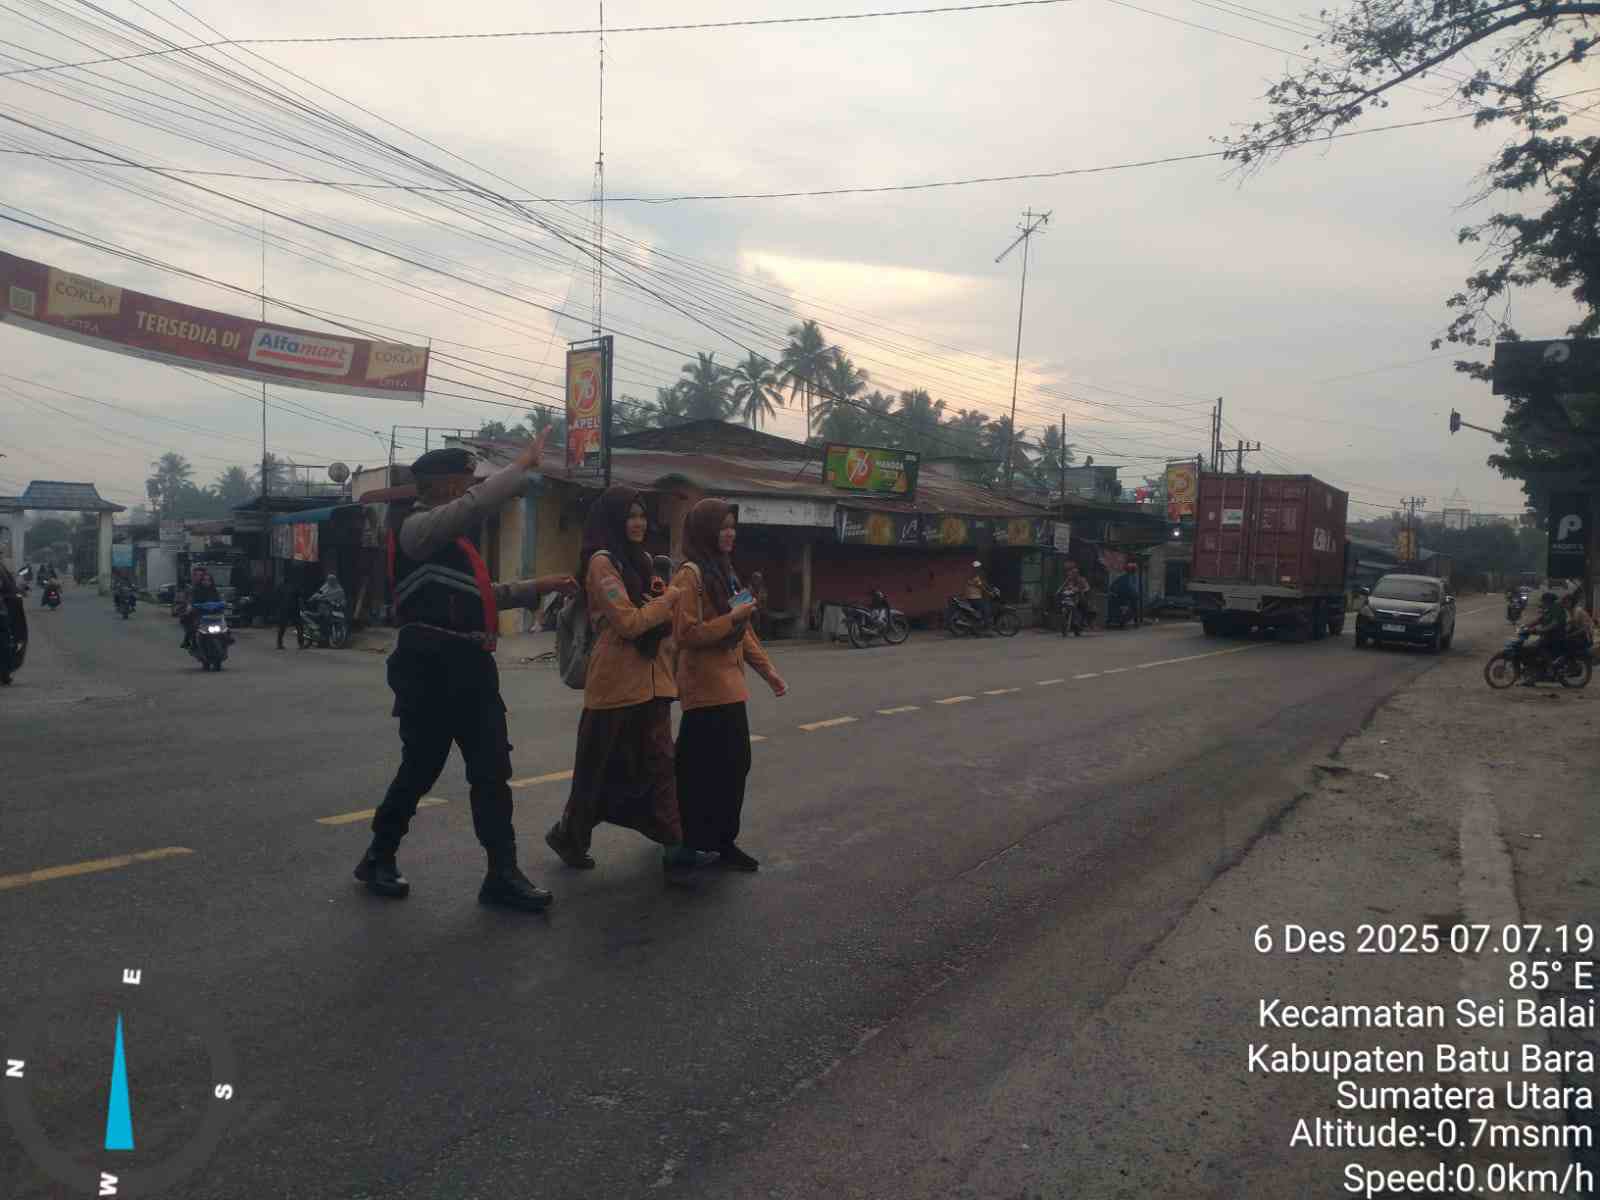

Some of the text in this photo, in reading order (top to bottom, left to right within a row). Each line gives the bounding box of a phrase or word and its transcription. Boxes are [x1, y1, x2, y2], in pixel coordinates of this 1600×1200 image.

[55, 281, 114, 309] COKLAT
[135, 309, 241, 351] TERSEDIA DI
[258, 332, 348, 361] Alfamart
